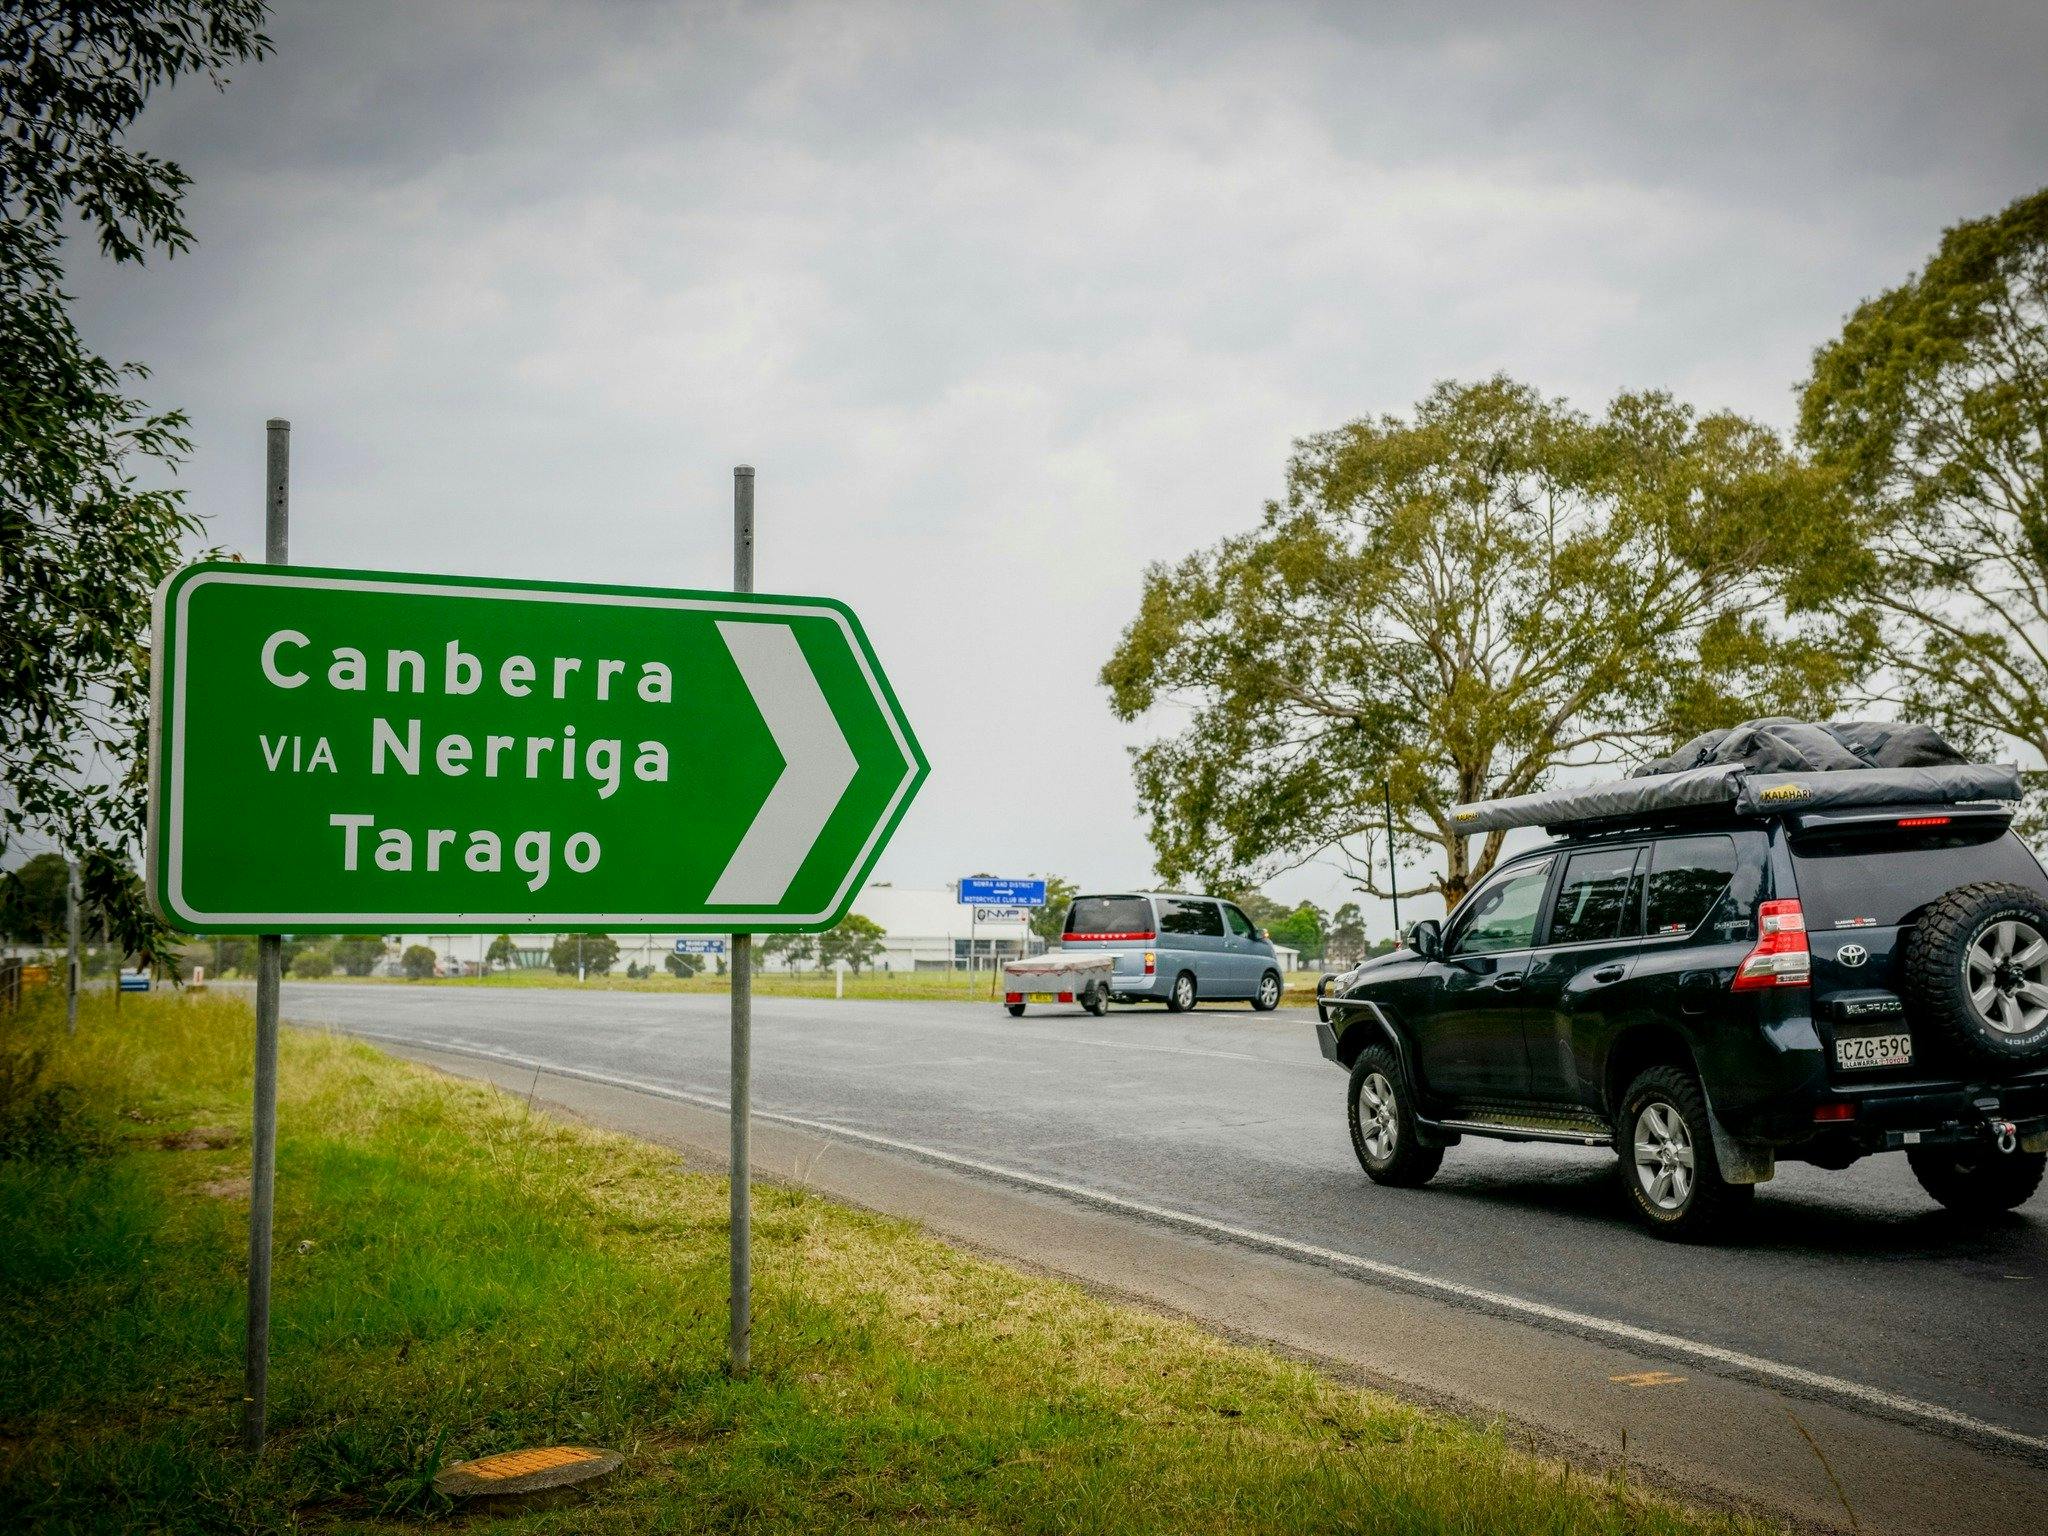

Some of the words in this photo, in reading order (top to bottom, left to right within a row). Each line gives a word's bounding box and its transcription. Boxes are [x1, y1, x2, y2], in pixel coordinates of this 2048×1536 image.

[261, 629, 673, 704] Canberra
[259, 734, 338, 774] VIA
[371, 717, 669, 800] Nerriga
[1764, 789, 1812, 800] KALAHARI
[329, 813, 601, 893] Tarago
[964, 896, 1001, 904] MOTORCYCLE
[1001, 896, 1017, 904] CLUB
